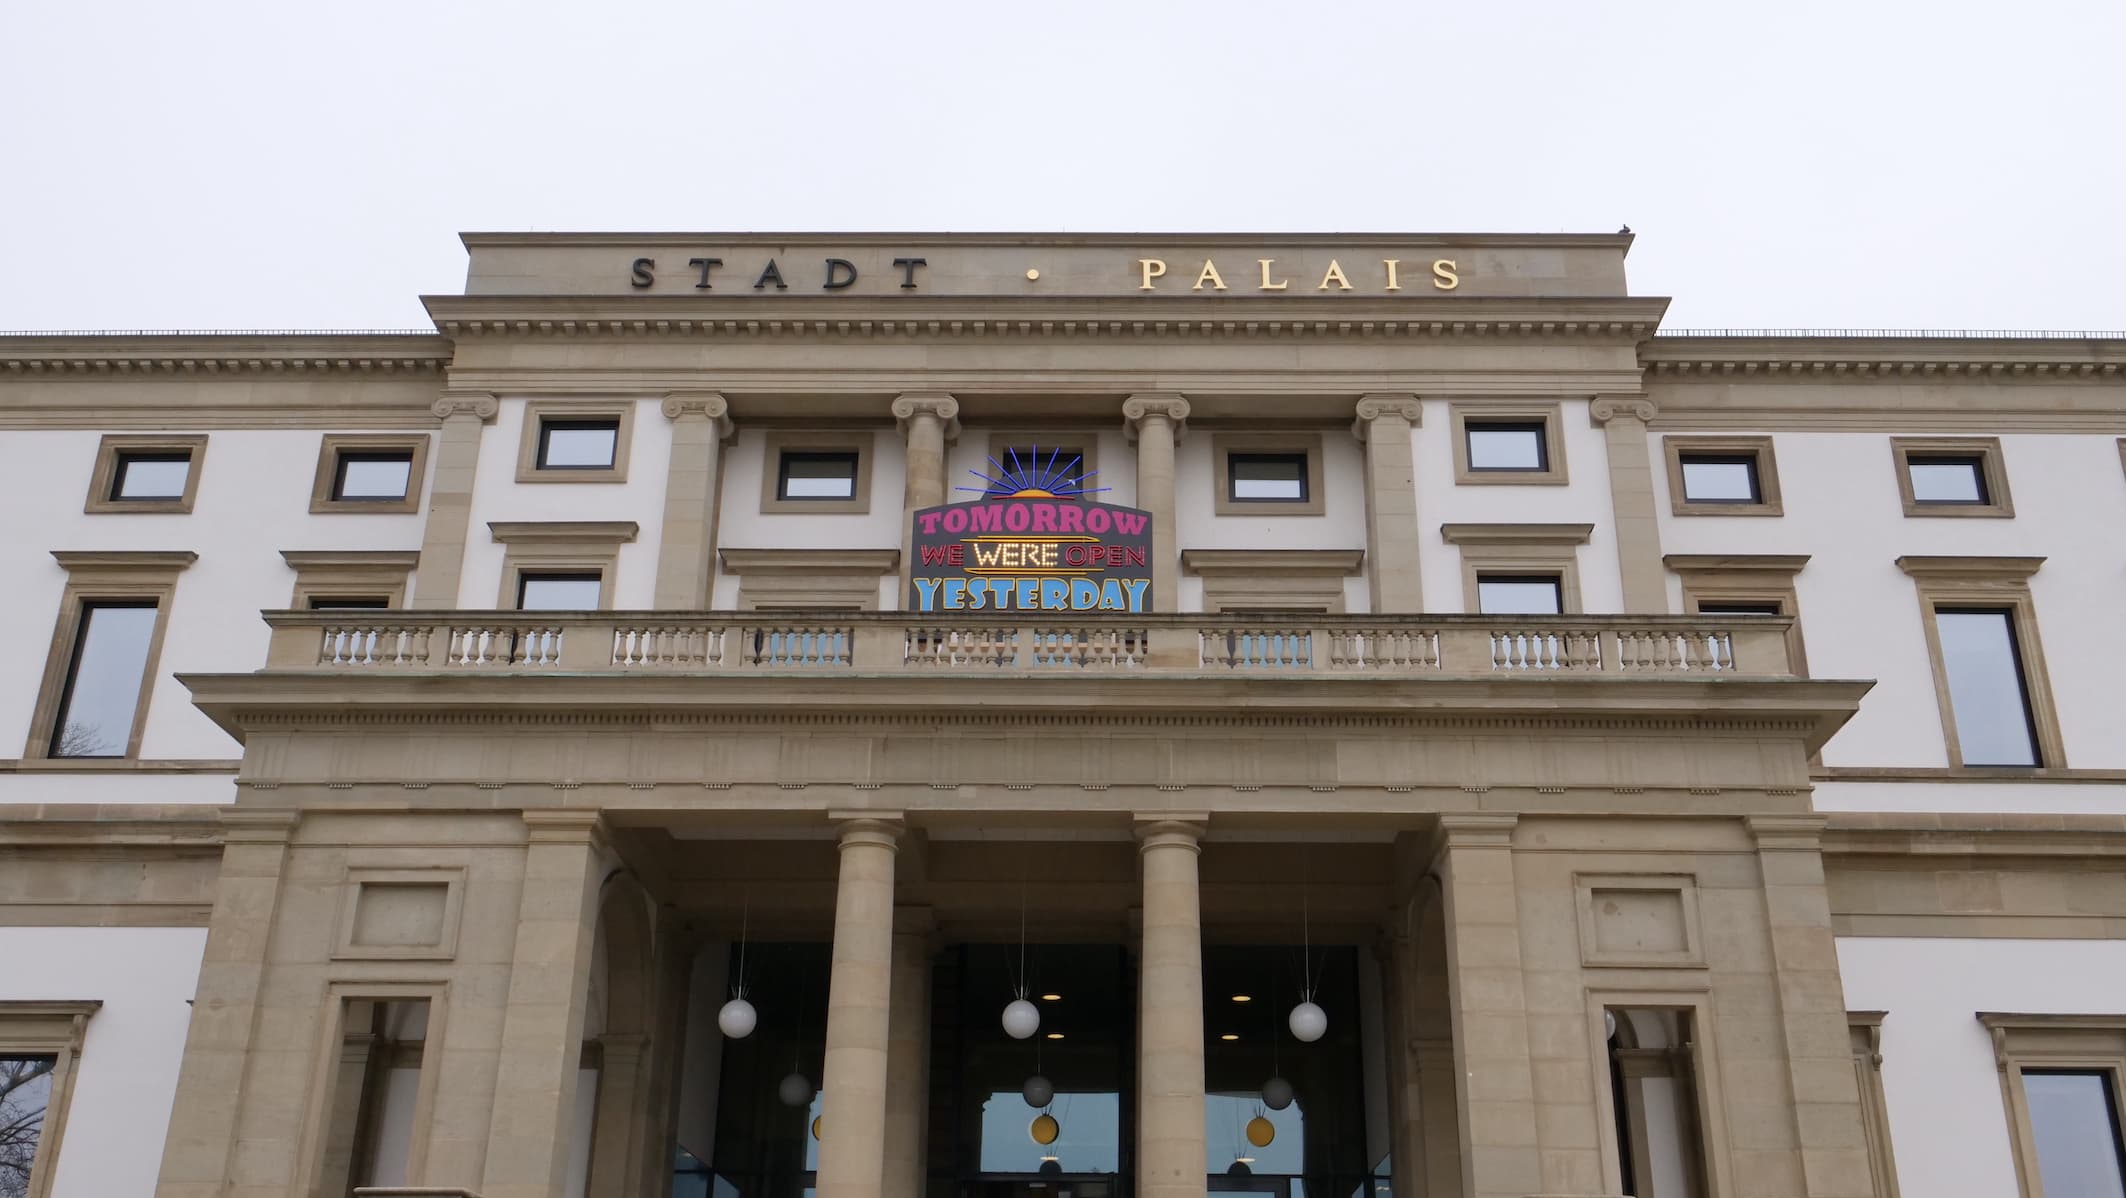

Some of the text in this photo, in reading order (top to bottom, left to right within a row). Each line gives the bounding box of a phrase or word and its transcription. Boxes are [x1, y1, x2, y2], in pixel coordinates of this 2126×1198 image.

[631, 258, 1460, 291] STADT PALAIS
[919, 503, 1148, 536] TOMORROW
[920, 543, 1146, 568] WE WERE OPEN
[913, 577, 1151, 613] YESTERDAY
